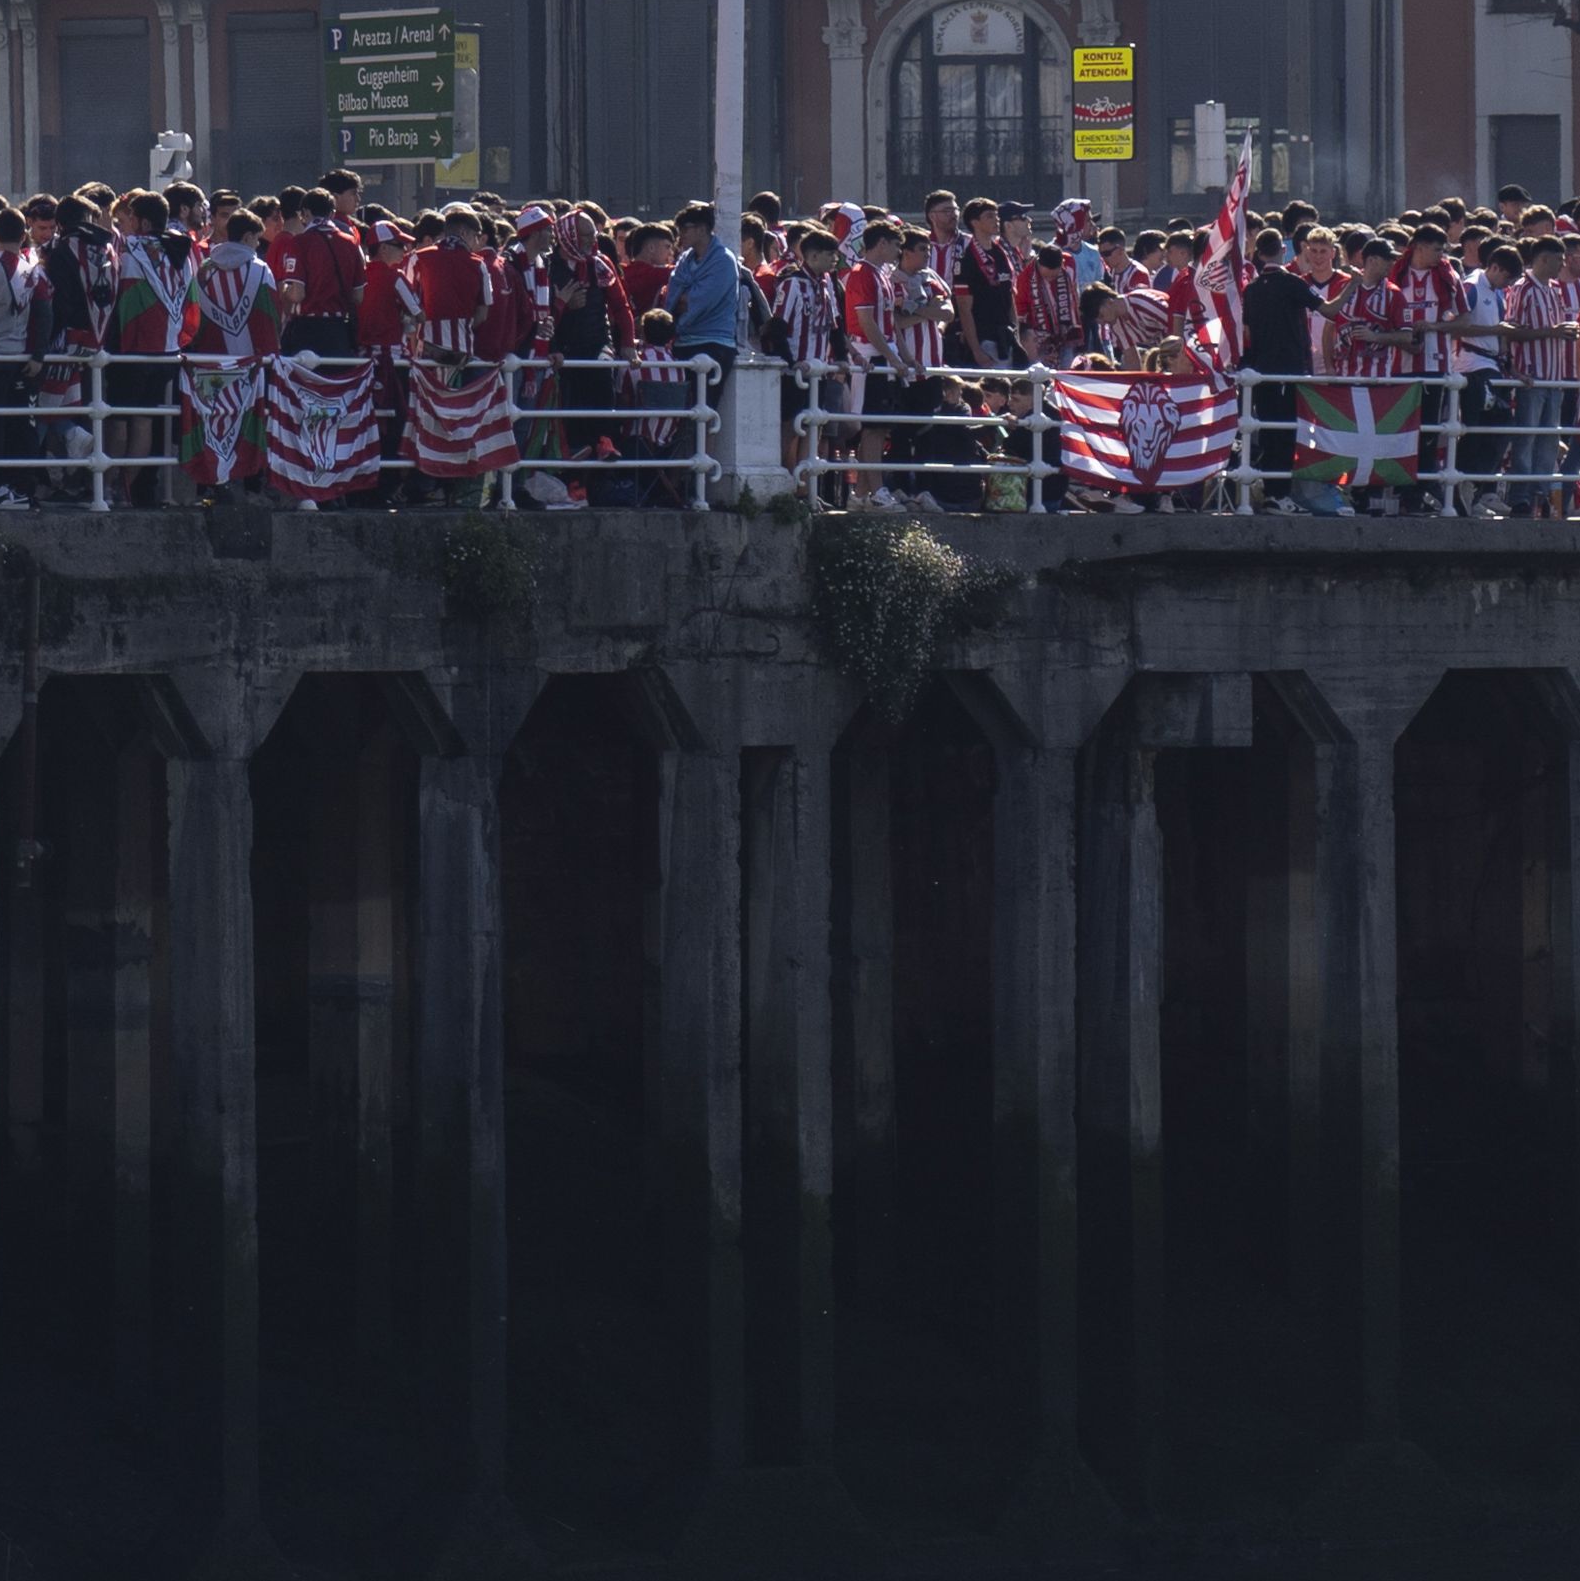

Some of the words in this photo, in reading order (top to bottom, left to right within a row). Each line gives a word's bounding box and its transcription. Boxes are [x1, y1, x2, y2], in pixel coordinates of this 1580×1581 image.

[962, 2, 1004, 12] CENTRO
[331, 28, 342, 50] P
[352, 28, 392, 47] Areatza
[400, 23, 435, 44] Arenal
[1083, 52, 1123, 61] KONTUZ
[357, 65, 419, 91] Guggenheim
[338, 93, 368, 112] Bilbao
[370, 91, 409, 110] Museoa
[341, 129, 352, 153] P
[387, 127, 419, 151] Baroja
[1076, 134, 1130, 143] LEHENTASUNA
[1083, 147, 1124, 155] PRIORIDAD
[1201, 261, 1226, 292] BILBAO
[211, 294, 252, 332] BILBAO
